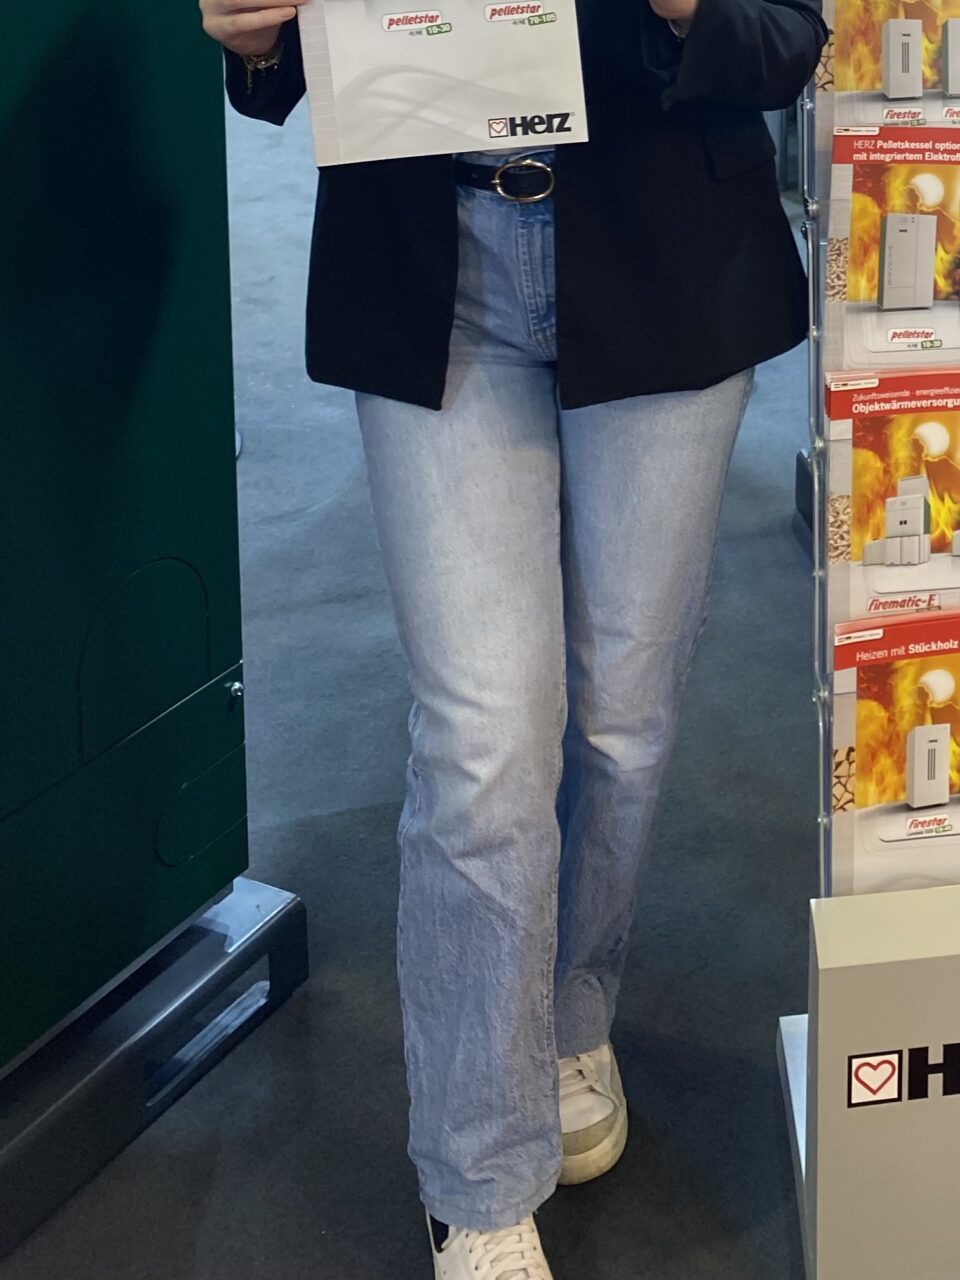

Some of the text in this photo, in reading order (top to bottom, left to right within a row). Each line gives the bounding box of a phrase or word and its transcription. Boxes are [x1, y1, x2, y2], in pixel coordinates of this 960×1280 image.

[490, 4, 541, 20] pelletstar
[387, 14, 440, 30] pelletstar
[427, 24, 451, 35] 10-30
[853, 140, 875, 149] HERZ
[877, 140, 933, 150] Pelletskessel
[853, 152, 867, 160] mit
[869, 152, 923, 162] integriertem
[891, 330, 934, 341] pelletstar
[852, 389, 911, 402] Zukunftsweisende
[856, 639, 959, 662] Heizen mit Stückholz
